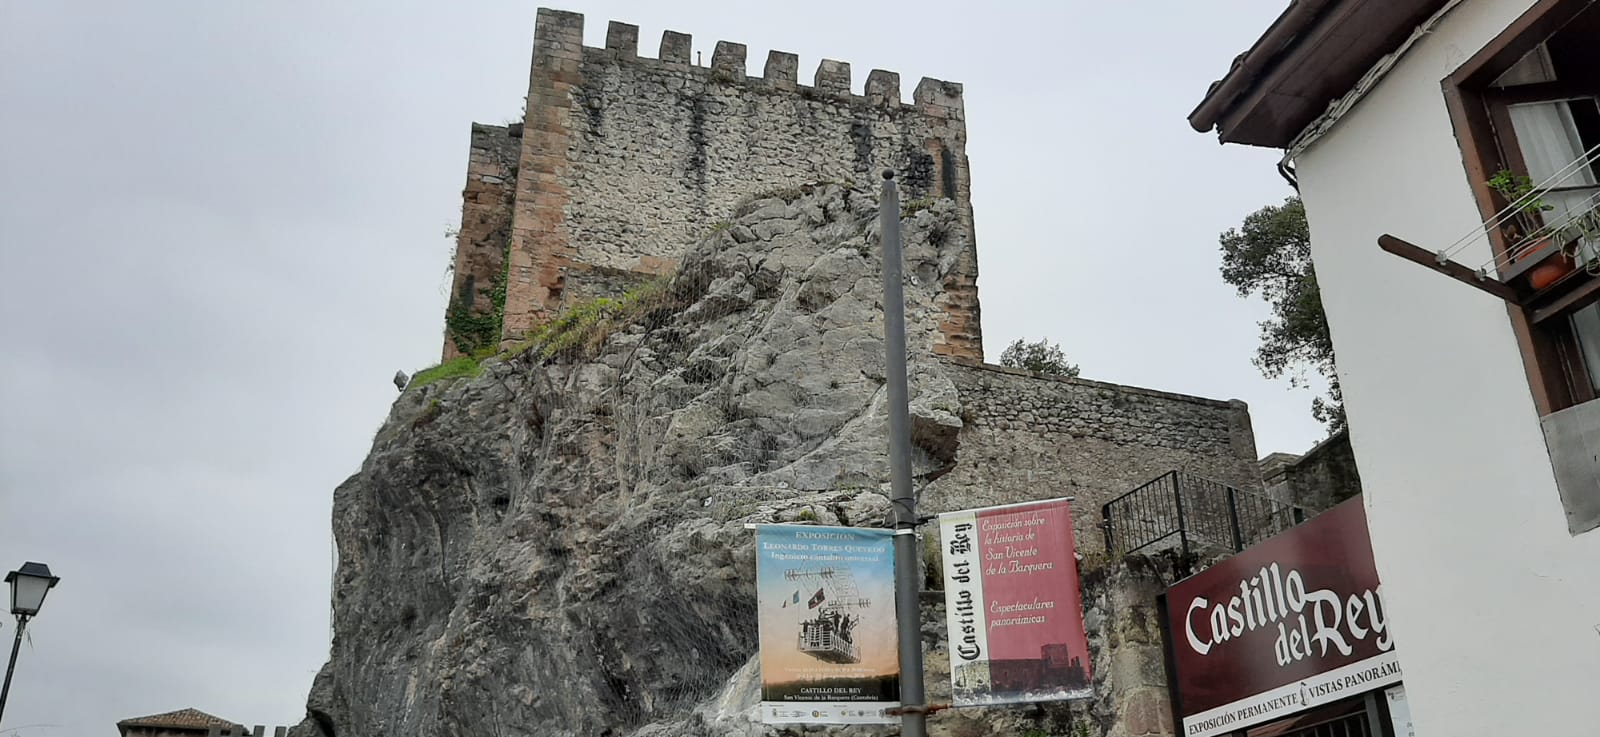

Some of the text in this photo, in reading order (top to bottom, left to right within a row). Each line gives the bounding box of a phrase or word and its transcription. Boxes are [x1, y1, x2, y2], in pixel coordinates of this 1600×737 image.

[982, 513, 1045, 535] Exposición sobre
[984, 528, 1035, 546] la historia de
[985, 546, 1038, 561] San Vicente
[985, 560, 1053, 577] de la Barquera
[950, 522, 981, 661] Castillo del Rey
[990, 596, 1055, 615] Espectaculares
[1185, 561, 1306, 656] Castillo
[990, 614, 1045, 631] panorámicas
[1274, 583, 1394, 667] del Rey
[1188, 708, 1237, 736] EXPOSICIÓN
[1237, 692, 1298, 721] PERMANENTE
[1308, 678, 1343, 699] VISTAS
